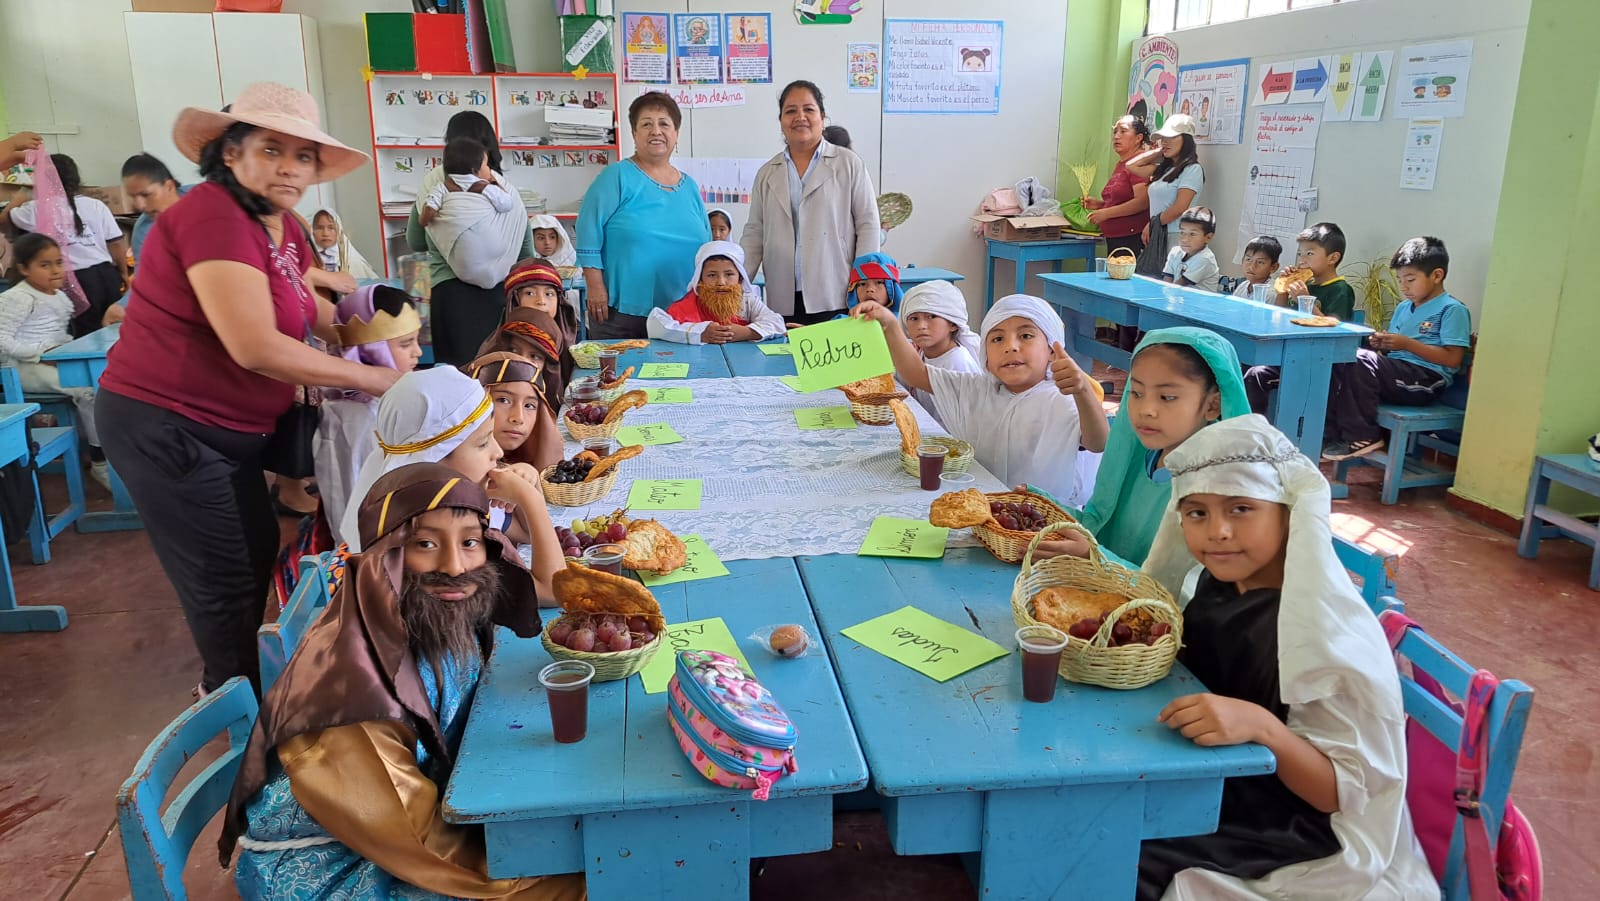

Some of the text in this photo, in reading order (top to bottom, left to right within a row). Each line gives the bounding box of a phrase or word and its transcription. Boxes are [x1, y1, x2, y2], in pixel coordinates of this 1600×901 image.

[1149, 41, 1176, 61] AMBIENTE
[395, 90, 487, 105] A B C D
[799, 337, 863, 370] Pedro
[891, 627, 960, 664] Judas
